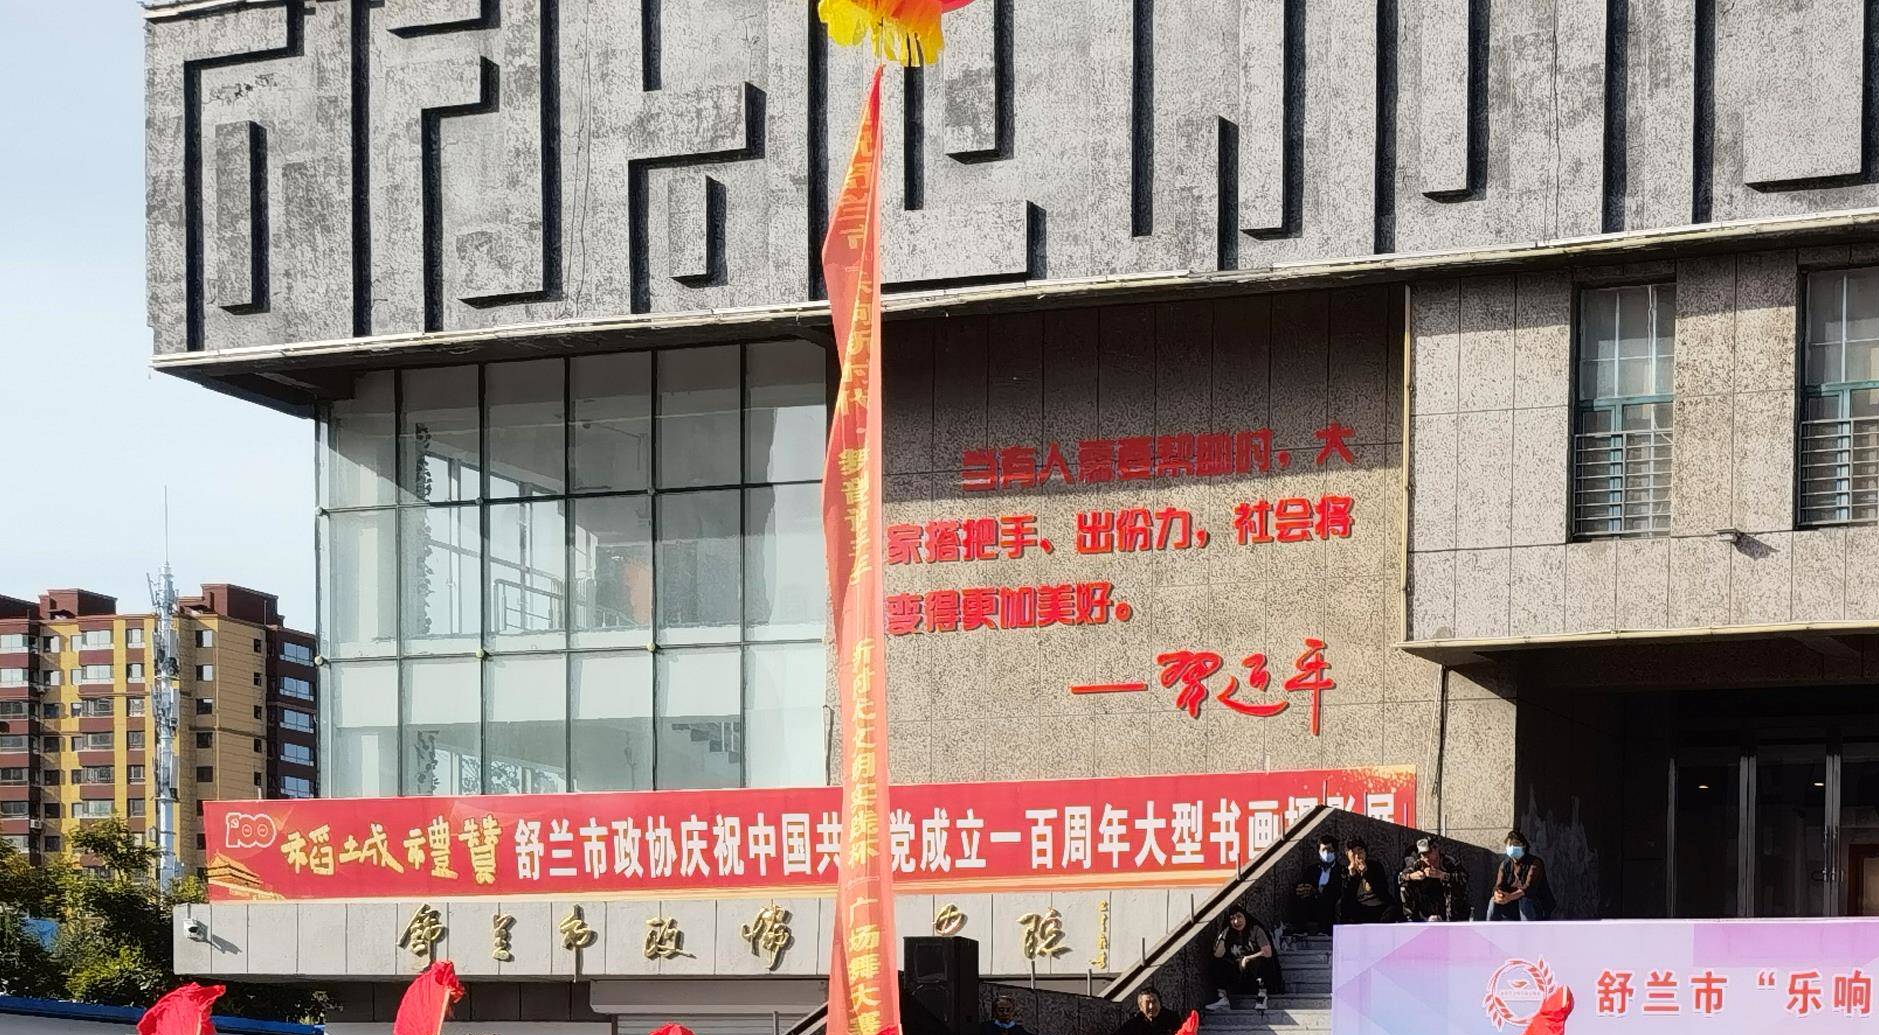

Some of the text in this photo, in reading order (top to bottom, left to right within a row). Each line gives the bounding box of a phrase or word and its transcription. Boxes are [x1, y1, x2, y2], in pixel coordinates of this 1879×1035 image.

[961, 422, 1355, 492] 当有人需要帮助时，大
[885, 495, 1355, 566] 家搭把手、出份力，社会将
[884, 581, 1133, 636] 变得更加美好。
[514, 792, 1396, 882] 舒兰市政协庆祝中国共党成立一百周年大型书画
